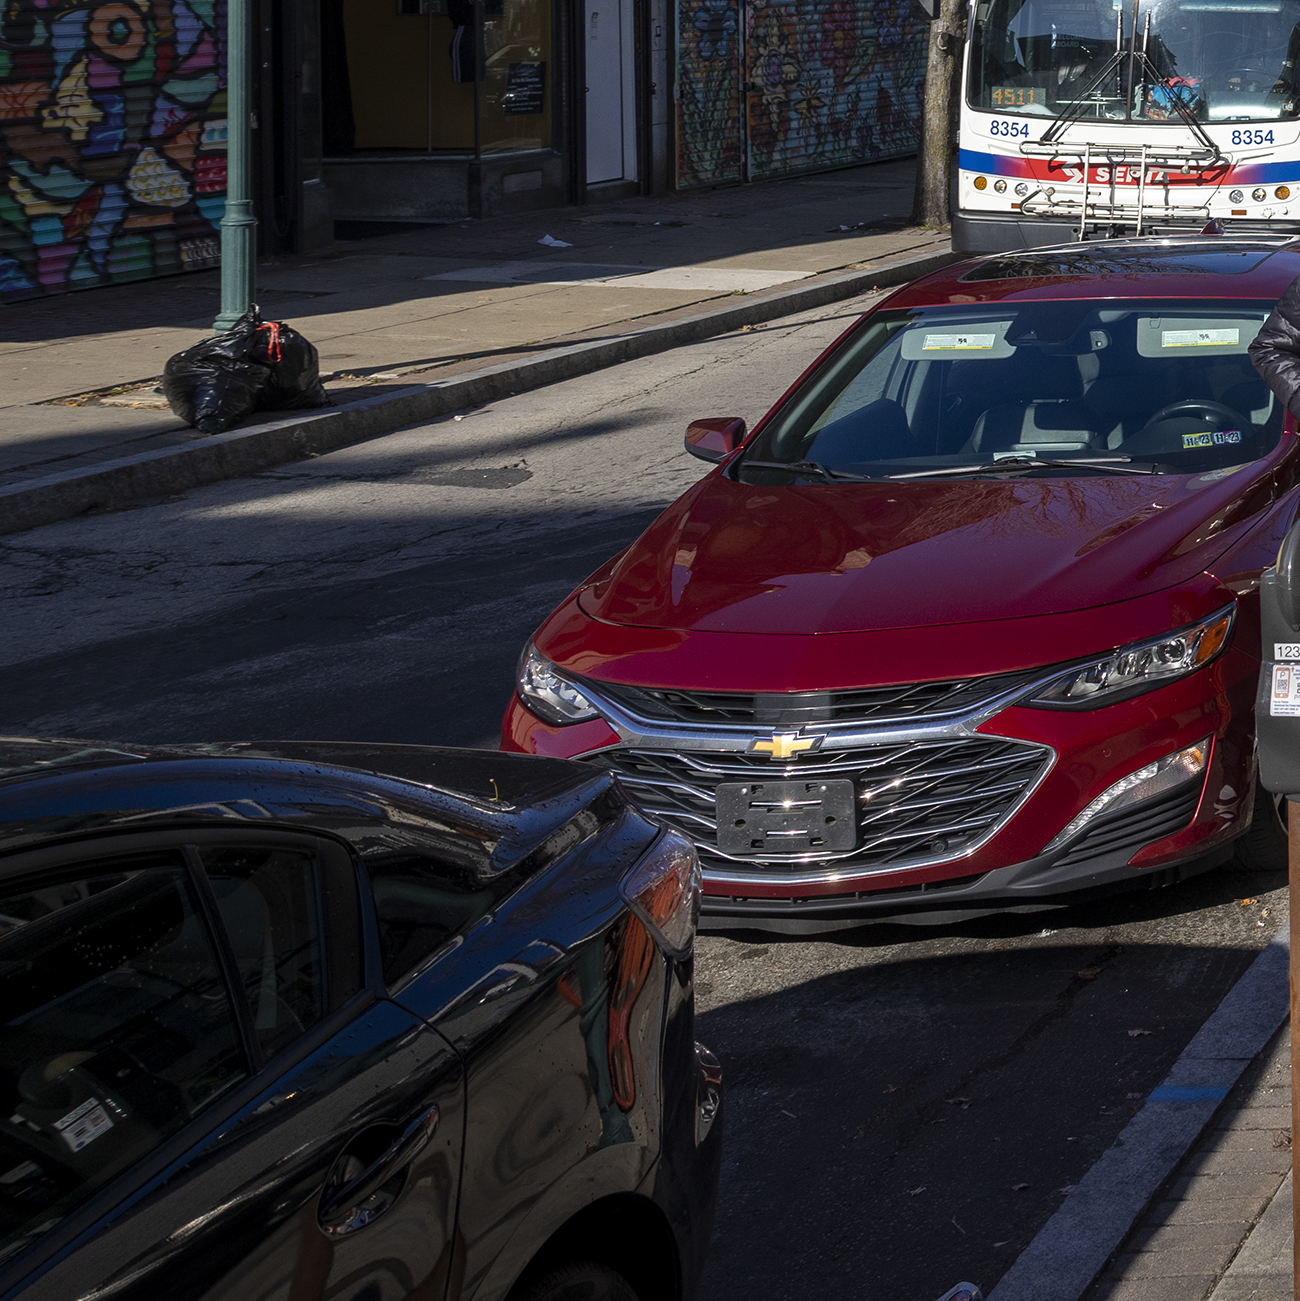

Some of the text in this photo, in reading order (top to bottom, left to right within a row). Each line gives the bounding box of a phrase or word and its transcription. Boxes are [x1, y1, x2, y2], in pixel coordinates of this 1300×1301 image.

[992, 87, 1035, 105] 4511
[989, 120, 1030, 139] 8354
[1231, 129, 1276, 146] 8354
[1094, 166, 1170, 184] SEPTA
[1200, 434, 1210, 444] 23
[1230, 432, 1240, 442] 23
